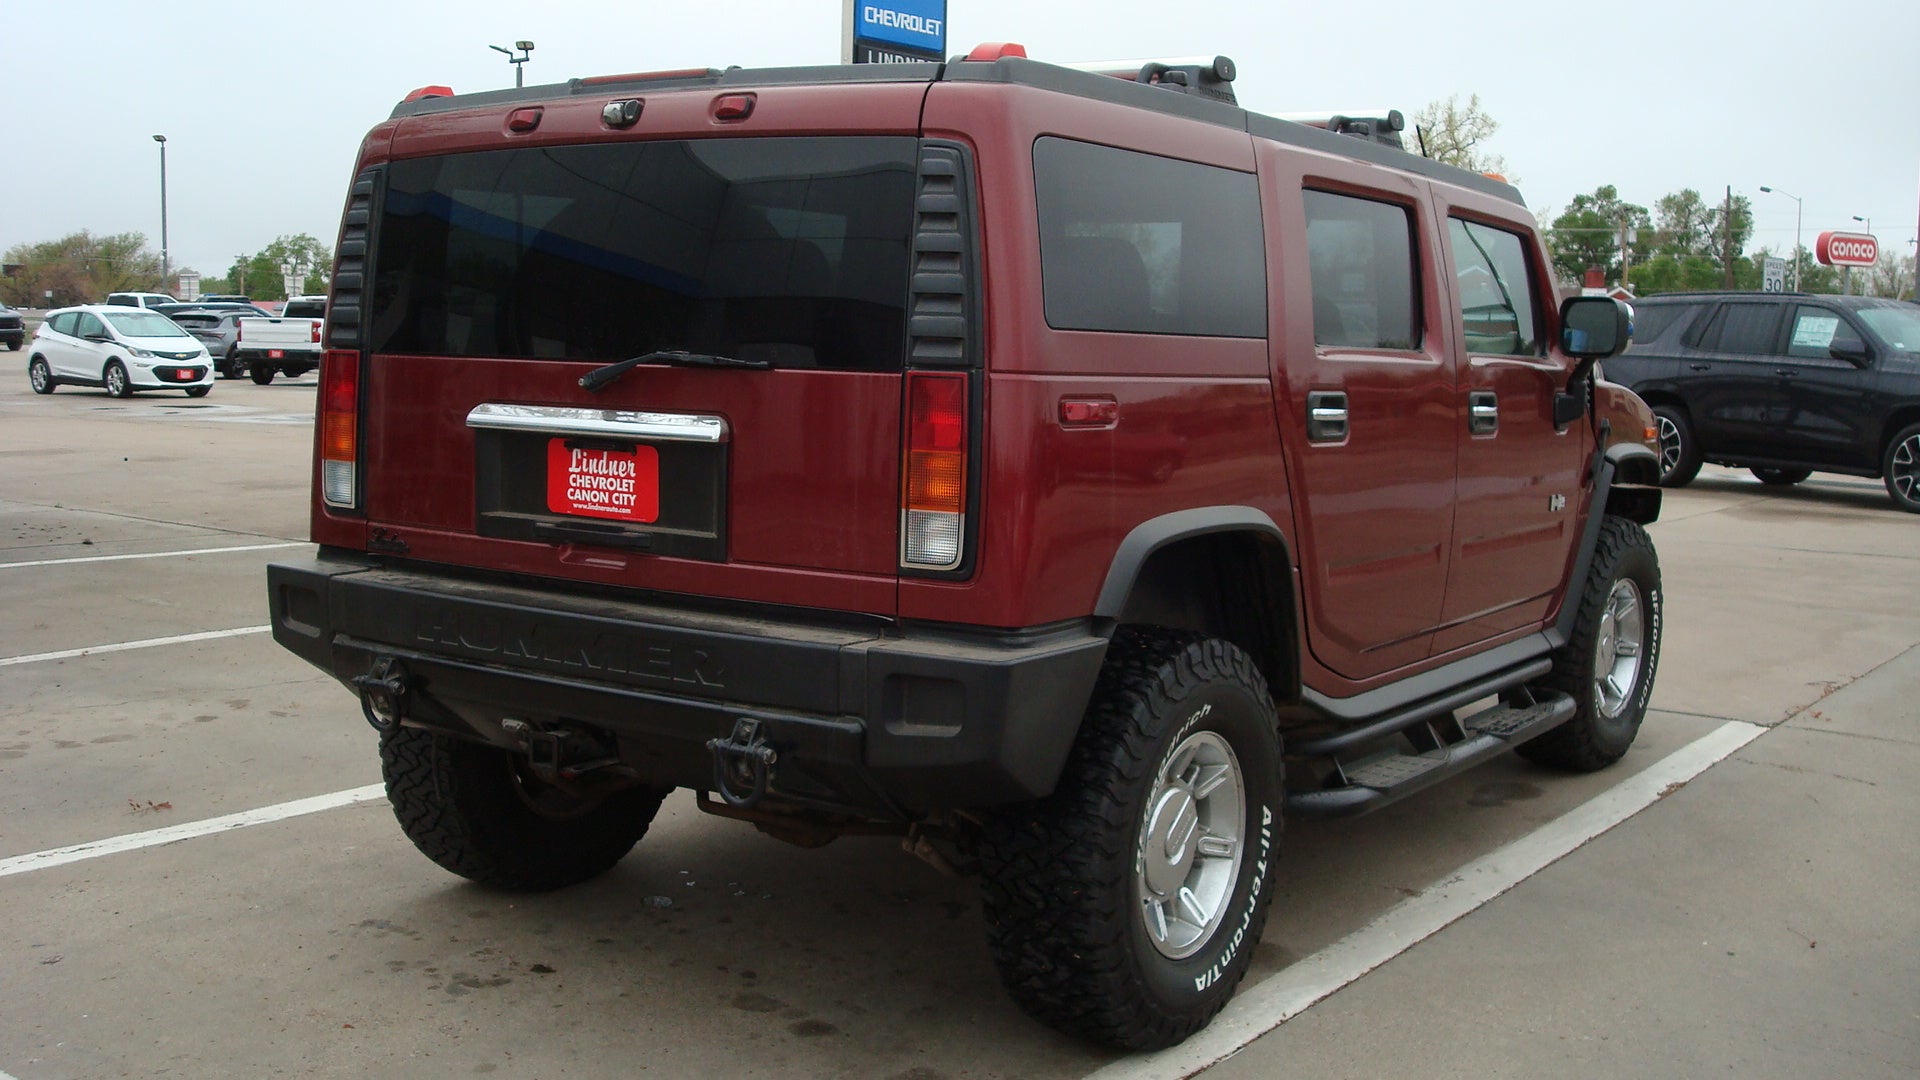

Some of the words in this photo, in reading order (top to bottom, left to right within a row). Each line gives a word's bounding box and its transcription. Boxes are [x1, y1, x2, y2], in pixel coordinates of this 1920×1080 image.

[864, 6, 942, 35] CHEVROLET
[1765, 278, 1782, 293] 30
[568, 448, 636, 477] Lindner
[567, 488, 609, 503] CANON
[612, 492, 636, 506] CITY
[569, 474, 636, 492] CHEVROLET
[1221, 804, 1272, 967] All-Terrain
[1194, 964, 1223, 992] T/A
